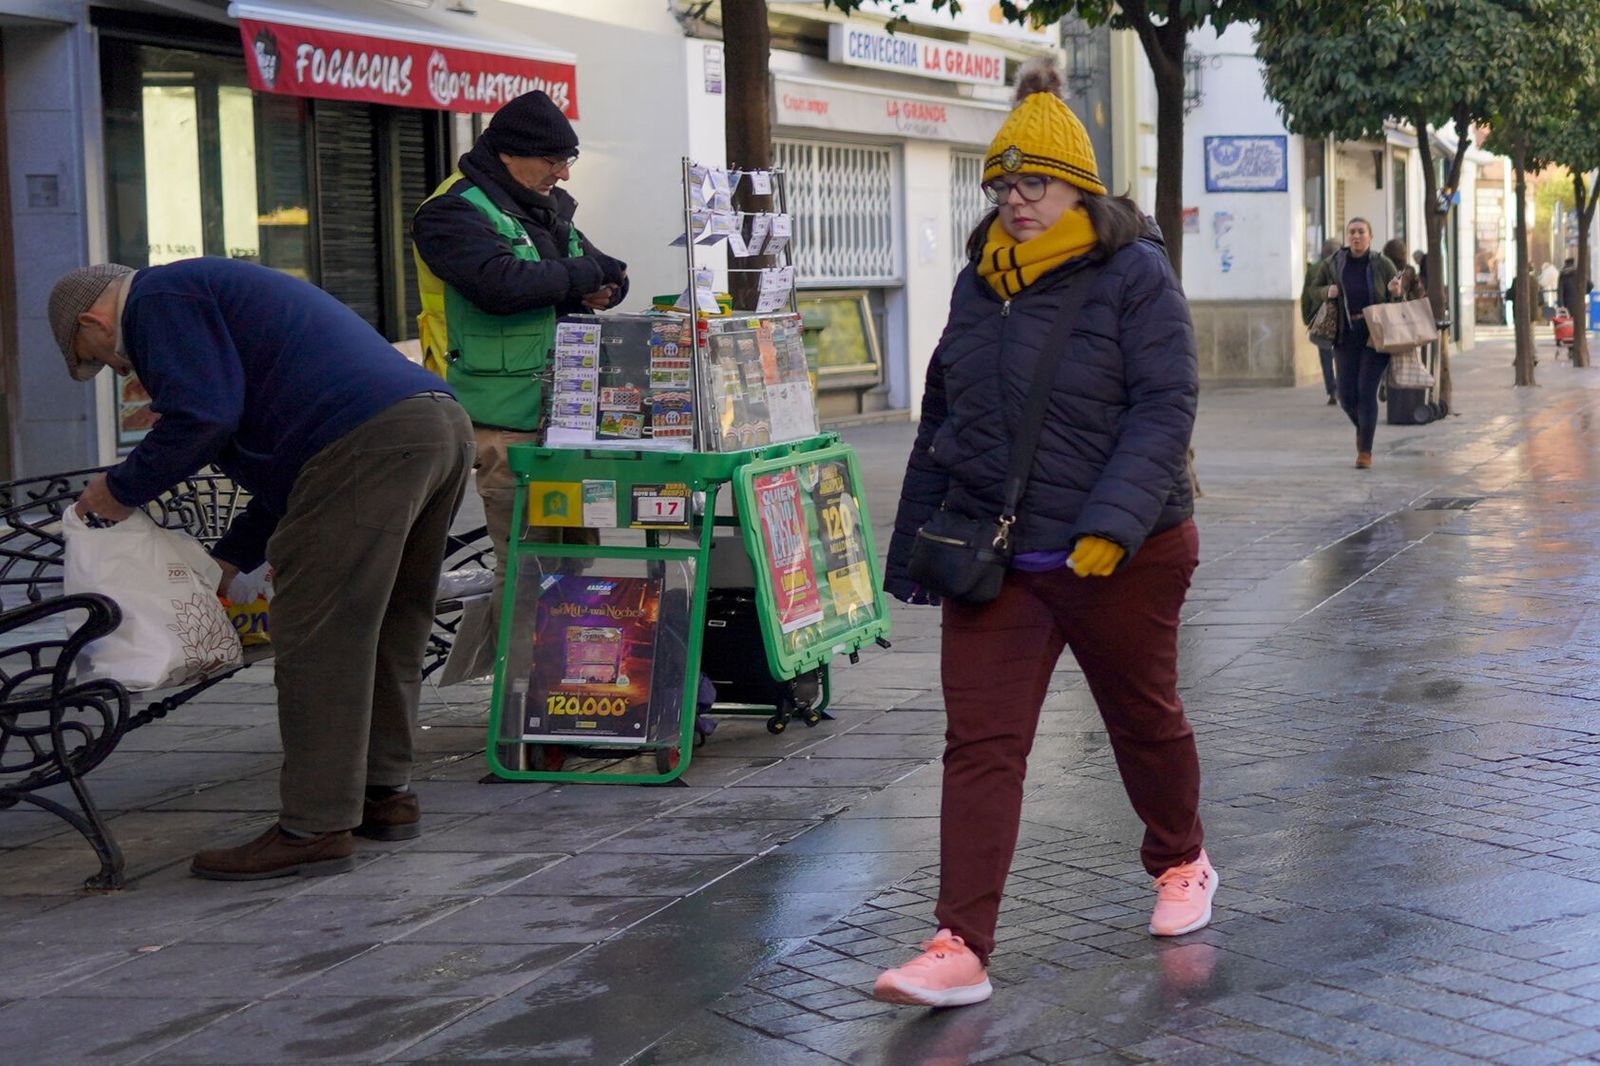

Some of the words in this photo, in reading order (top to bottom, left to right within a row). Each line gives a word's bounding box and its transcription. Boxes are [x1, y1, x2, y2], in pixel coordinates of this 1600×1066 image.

[848, 31, 918, 68] CERVECERIA
[923, 44, 941, 72] LA
[944, 49, 1001, 81] GRANDE
[296, 43, 413, 96] FOCACCIAS
[885, 98, 900, 119] LA
[902, 102, 948, 123] GRANDE
[655, 502, 678, 515] 17
[822, 504, 852, 540] 120
[168, 569, 188, 577] 70%
[604, 603, 646, 620] Noches
